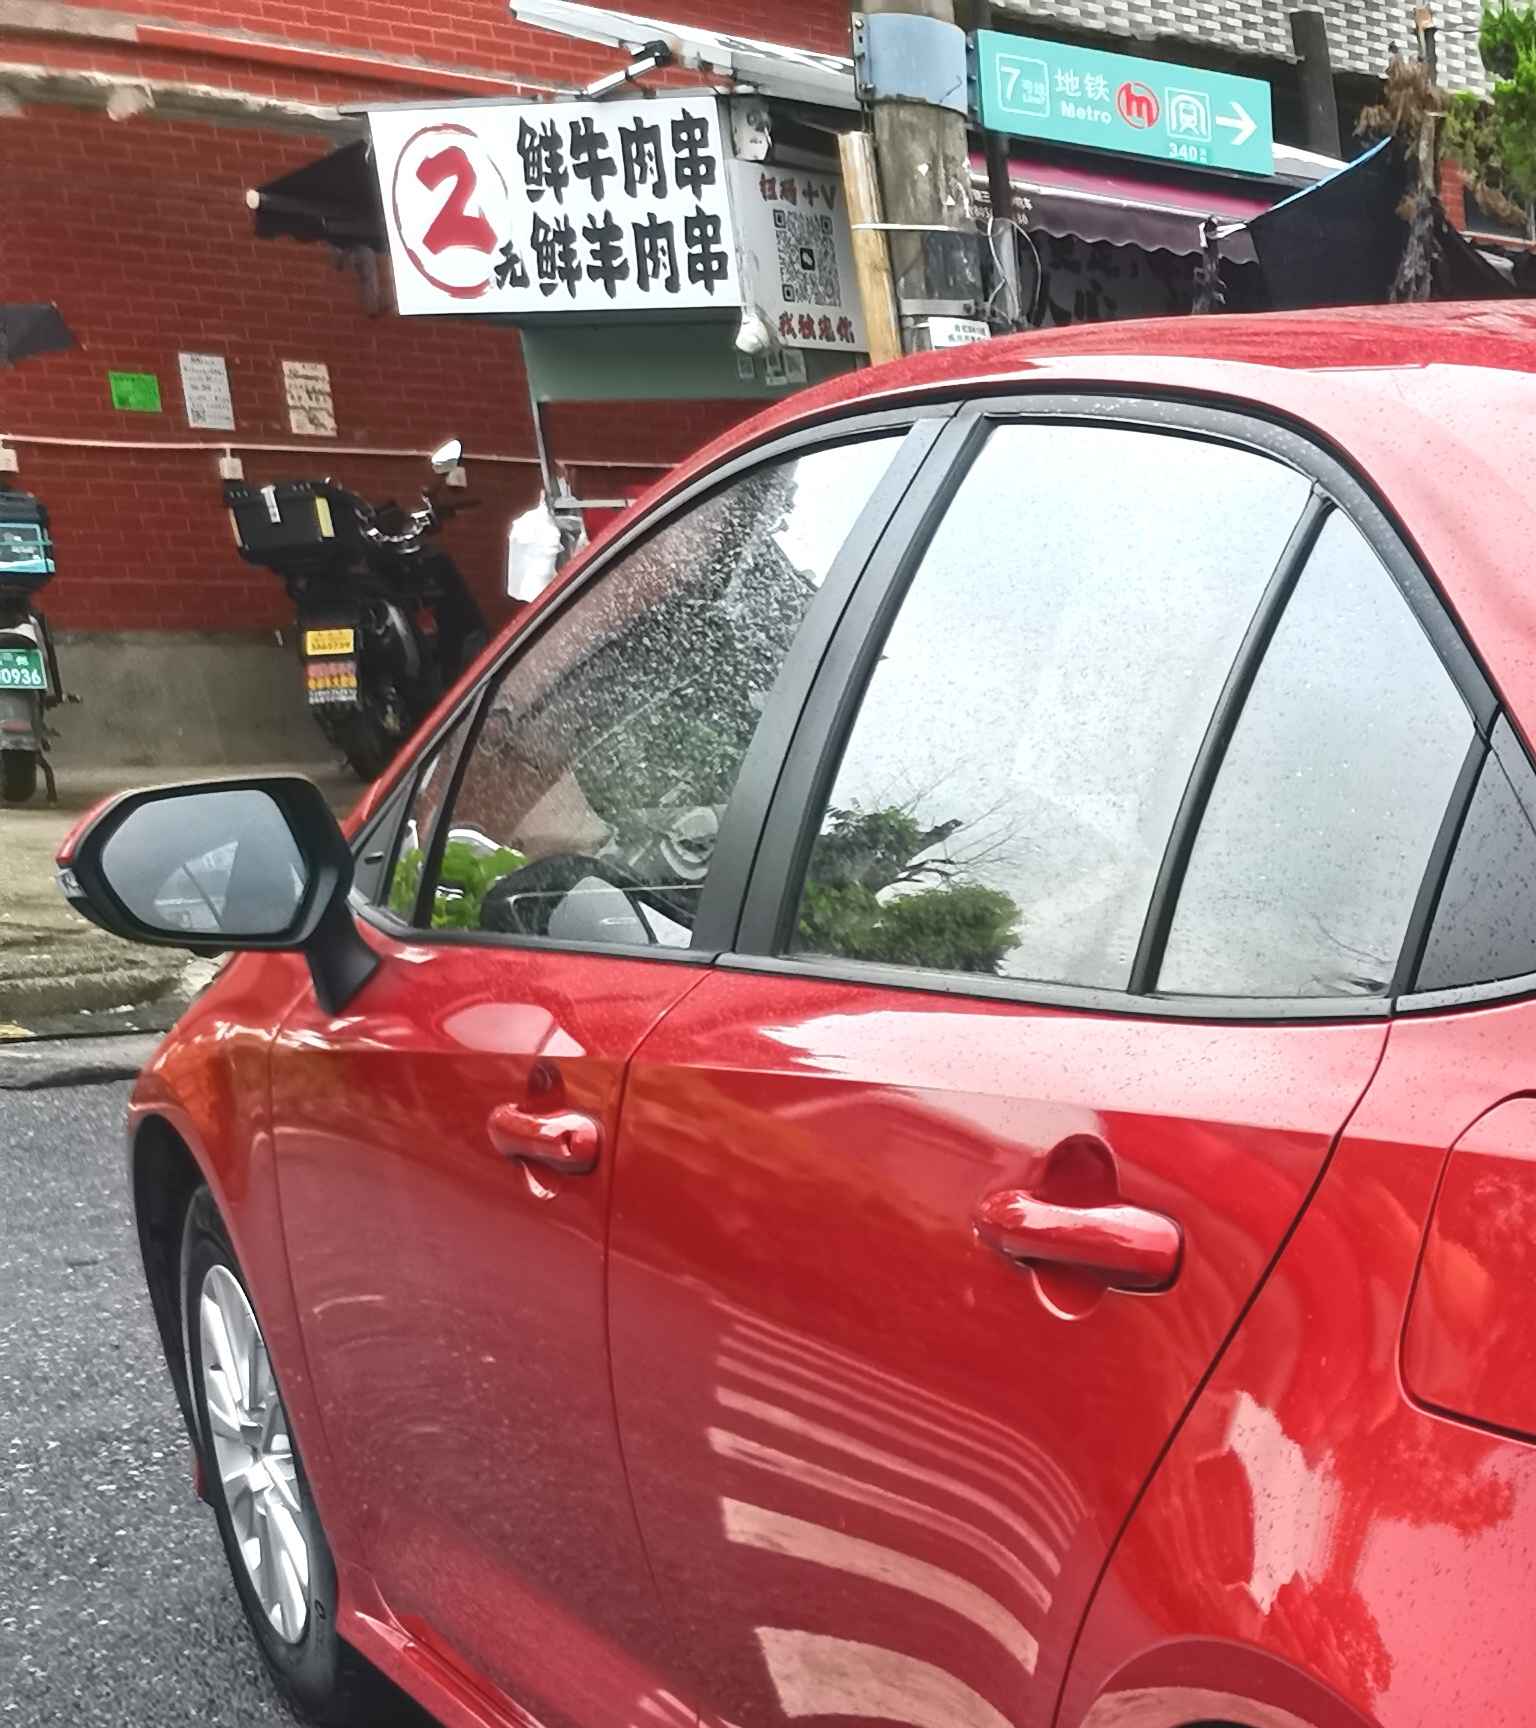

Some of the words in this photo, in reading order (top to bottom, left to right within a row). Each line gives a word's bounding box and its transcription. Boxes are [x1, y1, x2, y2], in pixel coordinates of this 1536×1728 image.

[1054, 67, 1111, 103] 地铁
[1061, 99, 1113, 125] Metro
[416, 146, 498, 256] 2
[517, 107, 717, 204] 鲜牛肉串
[530, 204, 729, 299] 鲜羊肉串
